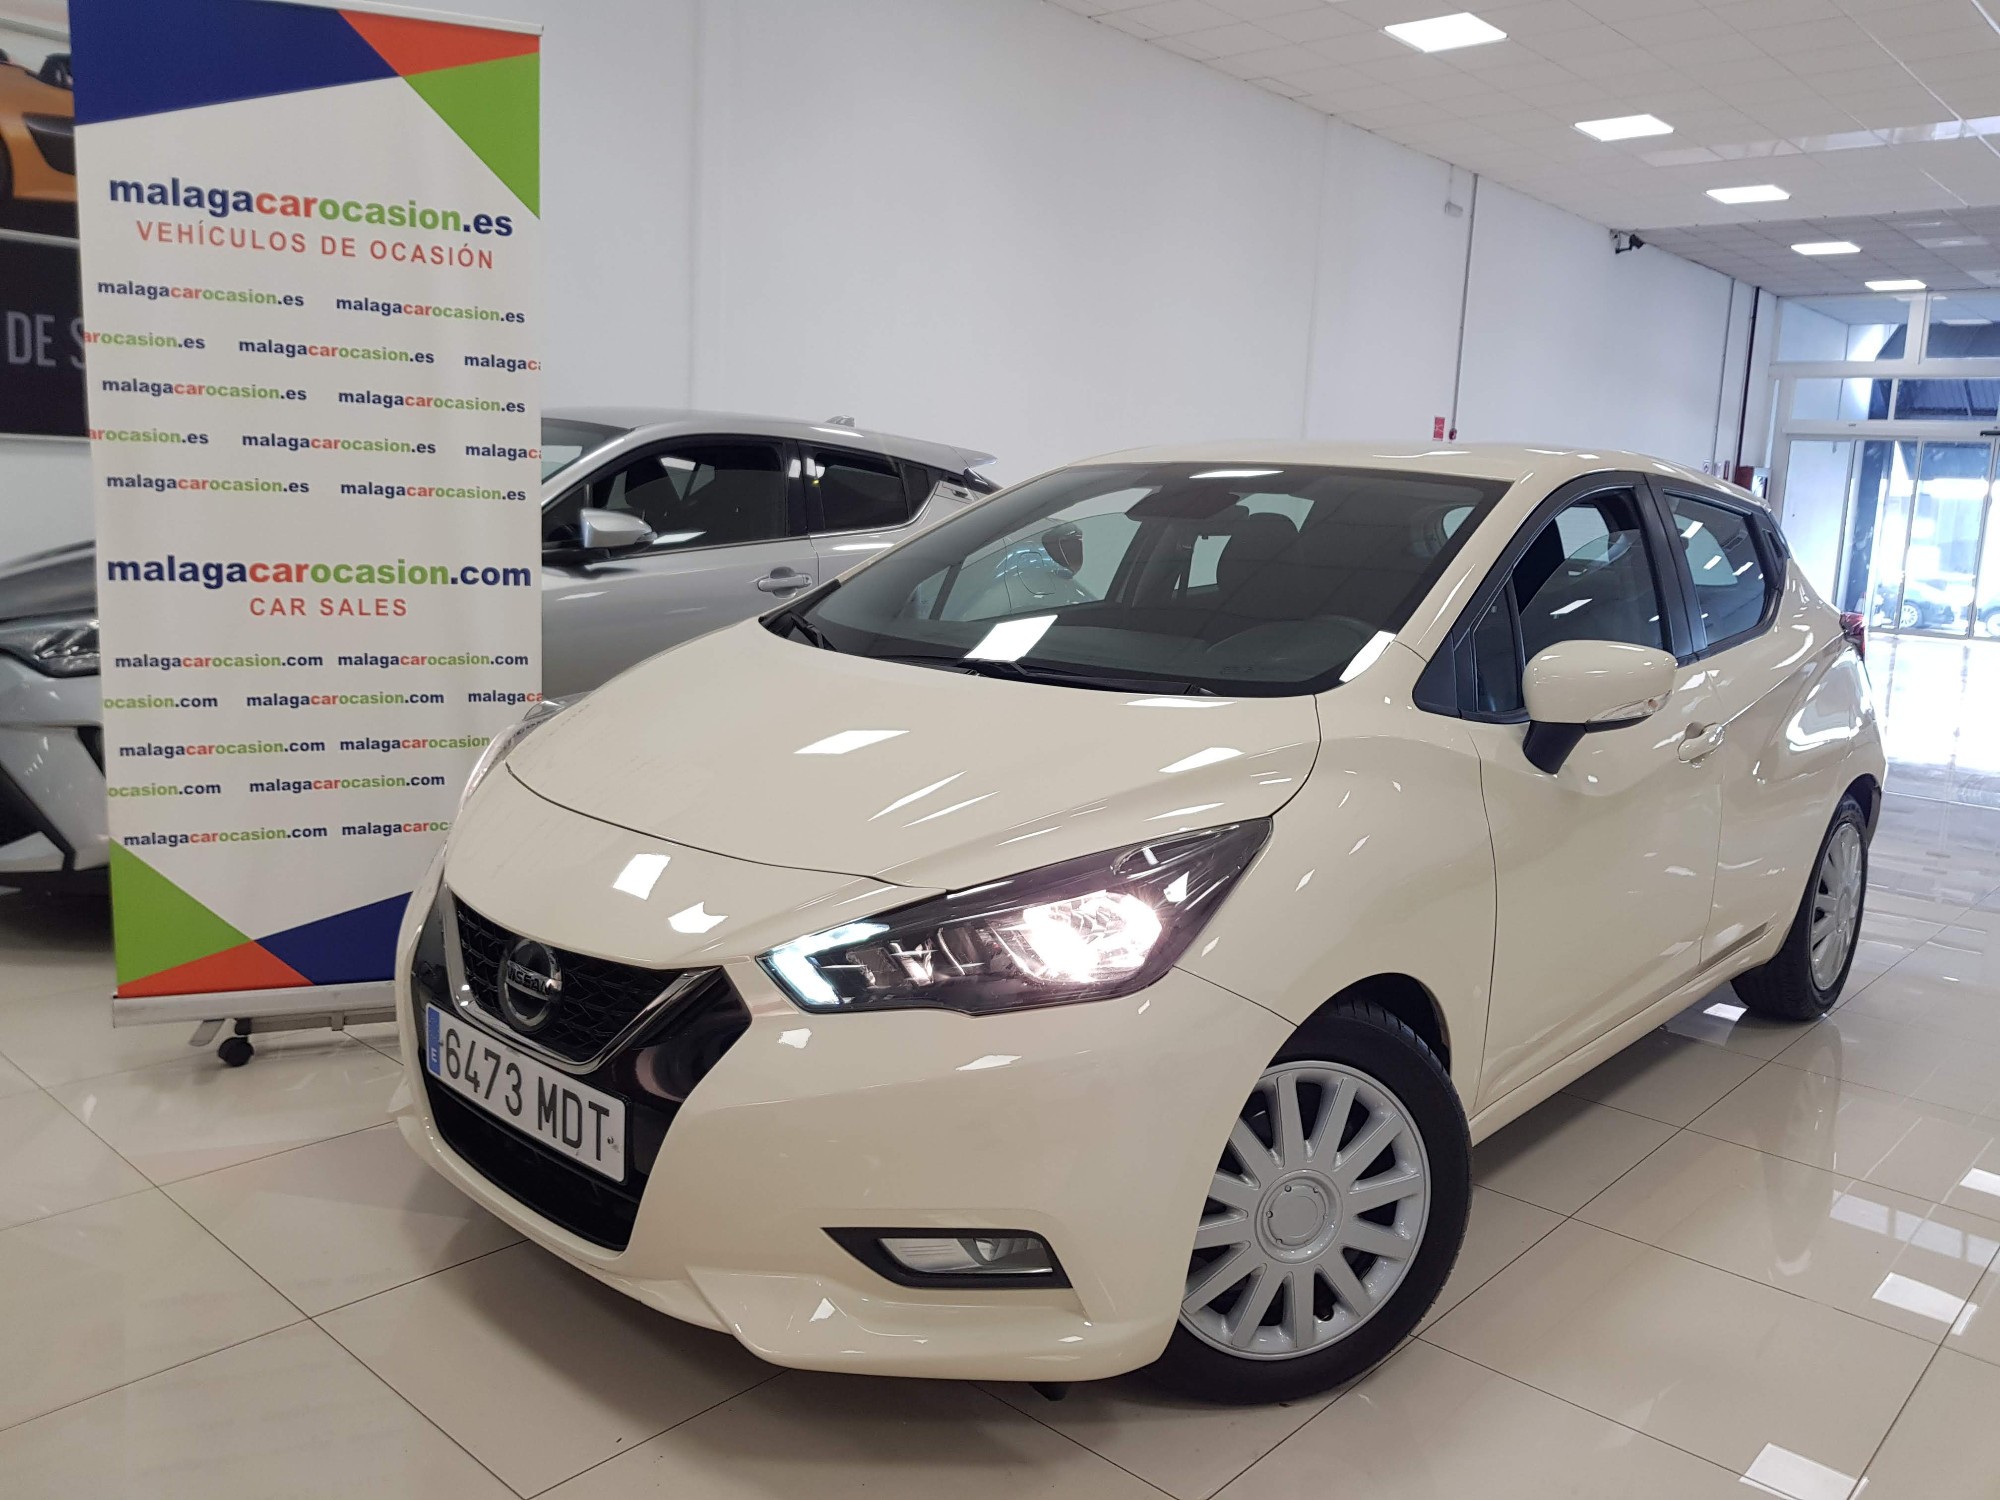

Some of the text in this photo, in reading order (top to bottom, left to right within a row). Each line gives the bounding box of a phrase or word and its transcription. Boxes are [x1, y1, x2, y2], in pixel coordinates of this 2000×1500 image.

[109, 177, 514, 236] malagacarocasion.es
[136, 220, 493, 269] VEHÍCULOS DE OCASIÓN
[97, 280, 526, 324] malagacarocasion.es malagacarocasion.es
[7, 312, 57, 367] DE
[239, 339, 435, 364] malagacarocasion.es
[102, 378, 526, 414] malagacarocasion.es malagacarocasion.es
[242, 433, 437, 456] malagacarocasion.es
[107, 474, 527, 502] malagacarocasion.es malagacarocasion.es
[107, 555, 532, 590] malagacarocasion.com
[249, 597, 408, 617] CAR SALES
[115, 652, 529, 671] malagacarocasion.com malagacarocasion.com
[103, 695, 219, 709] ocasion.com
[246, 691, 445, 710] malagacarocasion.com
[119, 734, 490, 759] malagacarocasion.com malagacarocasion
[108, 775, 445, 798] ocasion.com malagacarocasion.com
[123, 825, 328, 847] malagacarocasion.com
[430, 1028, 610, 1161] E 6473 MDT
